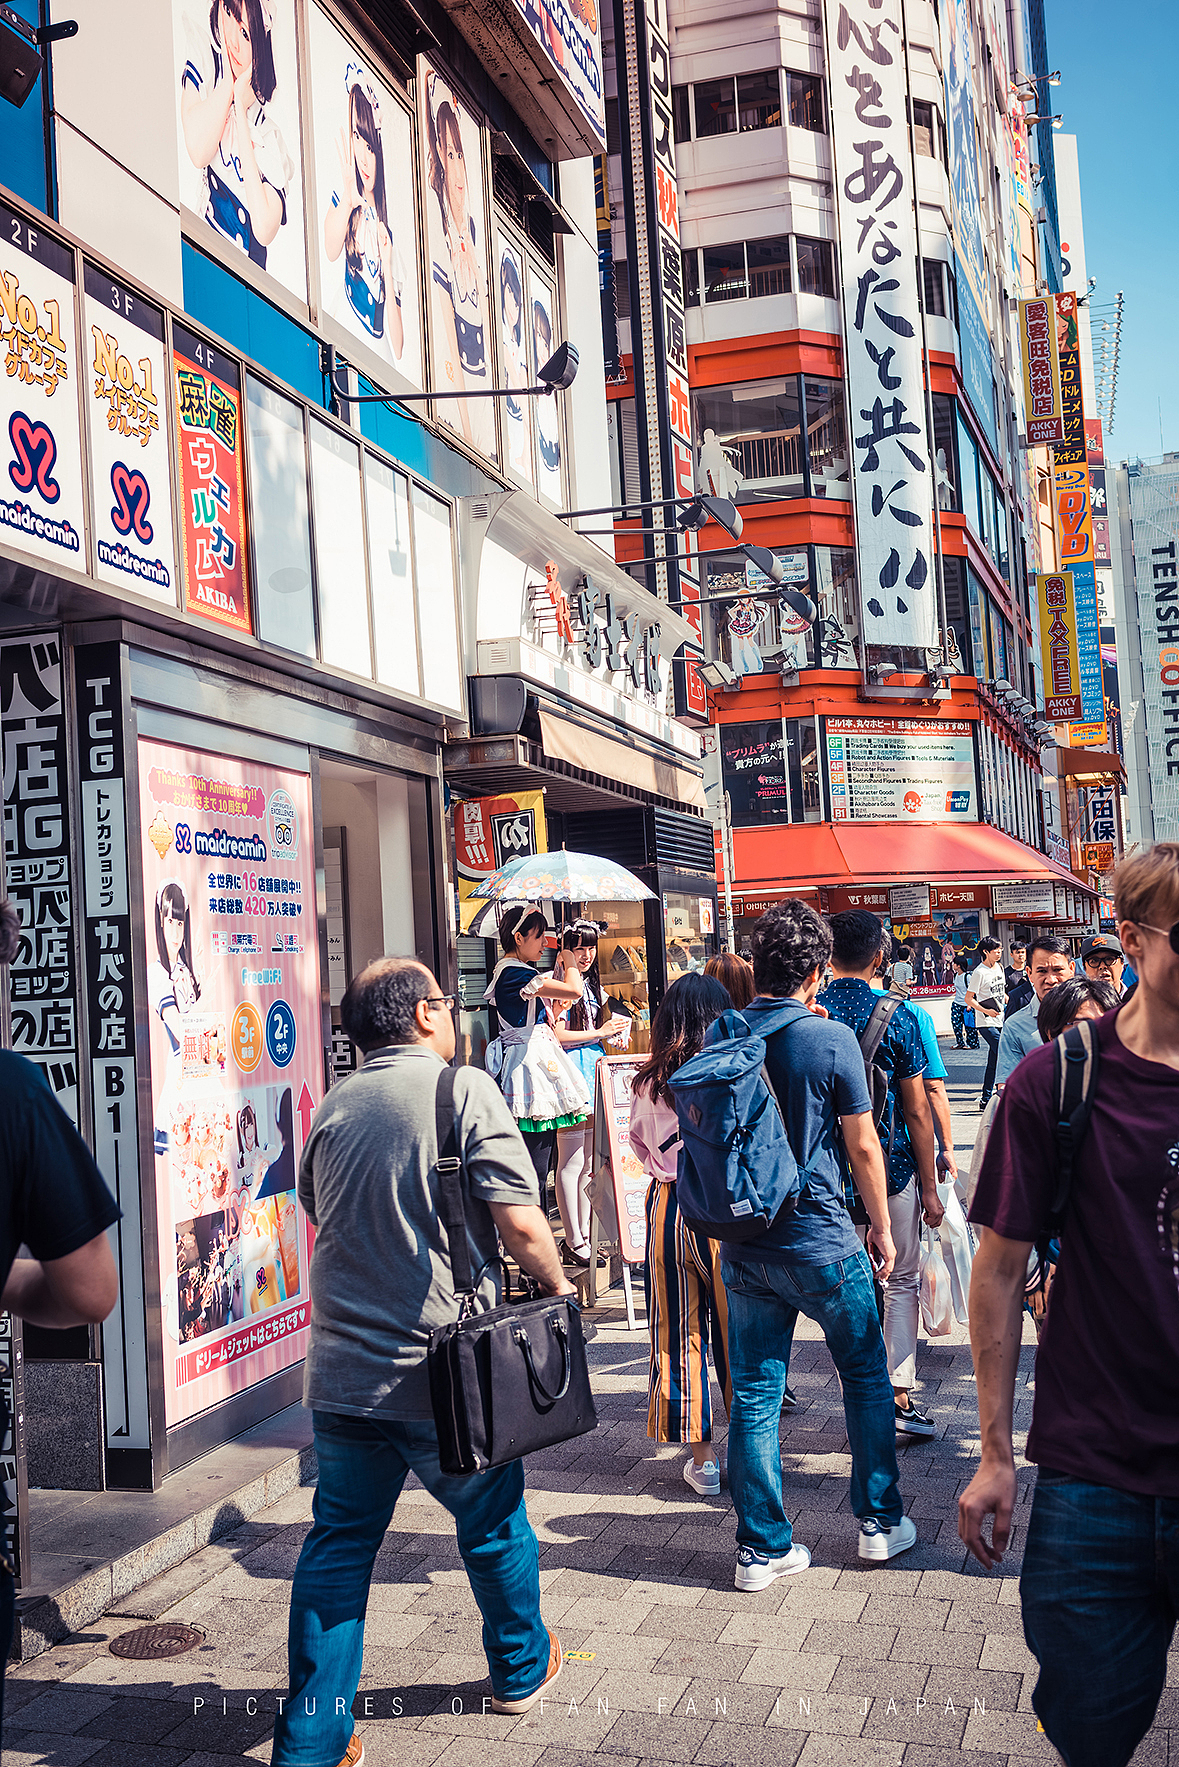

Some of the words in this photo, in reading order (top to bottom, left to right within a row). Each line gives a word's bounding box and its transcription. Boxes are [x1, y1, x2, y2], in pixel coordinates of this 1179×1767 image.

[11, 218, 38, 252] 2F
[0, 270, 66, 353] No.1
[111, 286, 134, 316] 3F
[836, 0, 928, 618] 心をあなたと共に!!
[0, 327, 68, 378] イドカフェ
[92, 326, 158, 405] No.1
[195, 343, 214, 369] 4F
[1059, 353, 1076, 365] ーム
[4, 352, 59, 397] グループ
[94, 379, 159, 430] メイドカフェ
[1061, 385, 1079, 398] ドル
[178, 370, 237, 452] 麻雀
[1062, 401, 1080, 413] ニメ
[106, 407, 151, 447] グループ
[1030, 420, 1058, 432] AKKY
[1033, 430, 1056, 440] ONE
[1063, 417, 1080, 430] ック
[1054, 450, 1082, 463] フィギュア
[190, 437, 236, 579] ウェルカム
[1058, 491, 1089, 558] DVD
[99, 542, 170, 586] maidreamin
[196, 582, 237, 614] AKIBA
[1046, 577, 1067, 607] 免税
[1048, 607, 1069, 646] TAX
[1050, 645, 1072, 695] FREE
[1048, 698, 1077, 708] AKKY
[1052, 707, 1075, 716] ONE
[86, 677, 115, 774] TCG
[829, 738, 841, 747] 6F
[831, 750, 841, 759] 5F
[831, 763, 843, 771] 4F
[832, 774, 844, 783] 3F
[156, 770, 186, 787] Thanks
[189, 776, 207, 792] 10th
[209, 780, 257, 802] Anniversary!!
[833, 785, 845, 794] 2F
[834, 797, 844, 806] 1F
[835, 809, 846, 818] B1
[96, 789, 115, 909] トレカショップ
[196, 830, 266, 861] maidreamin
[8, 858, 65, 884] ョップ
[863, 895, 886, 905] 秋葉原
[939, 892, 974, 902] ホビー天国
[10, 971, 69, 995] ョップ
[94, 920, 126, 1051] カベの店
[238, 1016, 255, 1044] 3F
[273, 1013, 289, 1040] 2F
[276, 1043, 288, 1055] 中央
[105, 1065, 126, 1135] B1
